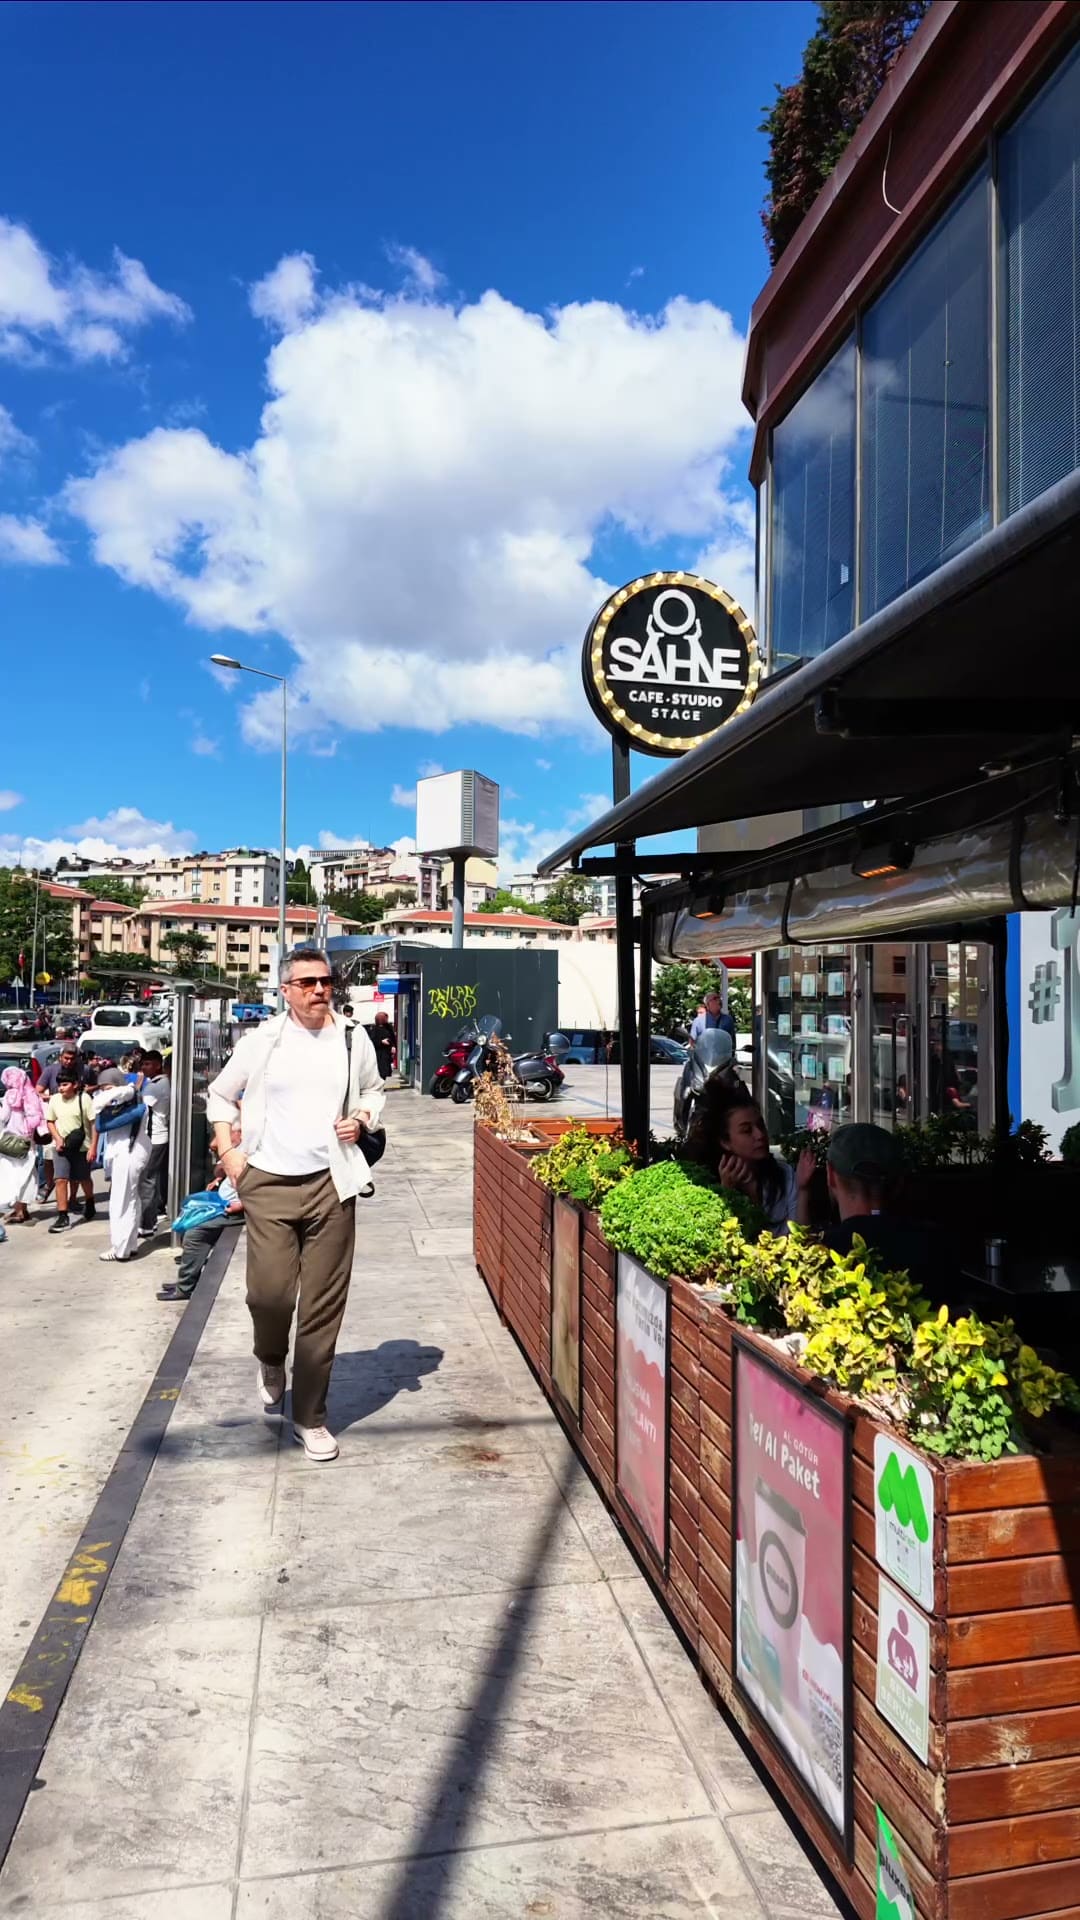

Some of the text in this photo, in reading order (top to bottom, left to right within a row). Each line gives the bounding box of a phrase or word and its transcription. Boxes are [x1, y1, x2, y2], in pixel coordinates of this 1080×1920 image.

[609, 634, 742, 688] SAHNE
[628, 690, 723, 708] CAFE STUDIO
[651, 707, 701, 721] STAGE
[765, 1431, 777, 1461] Al
[781, 1443, 820, 1499] Paket
